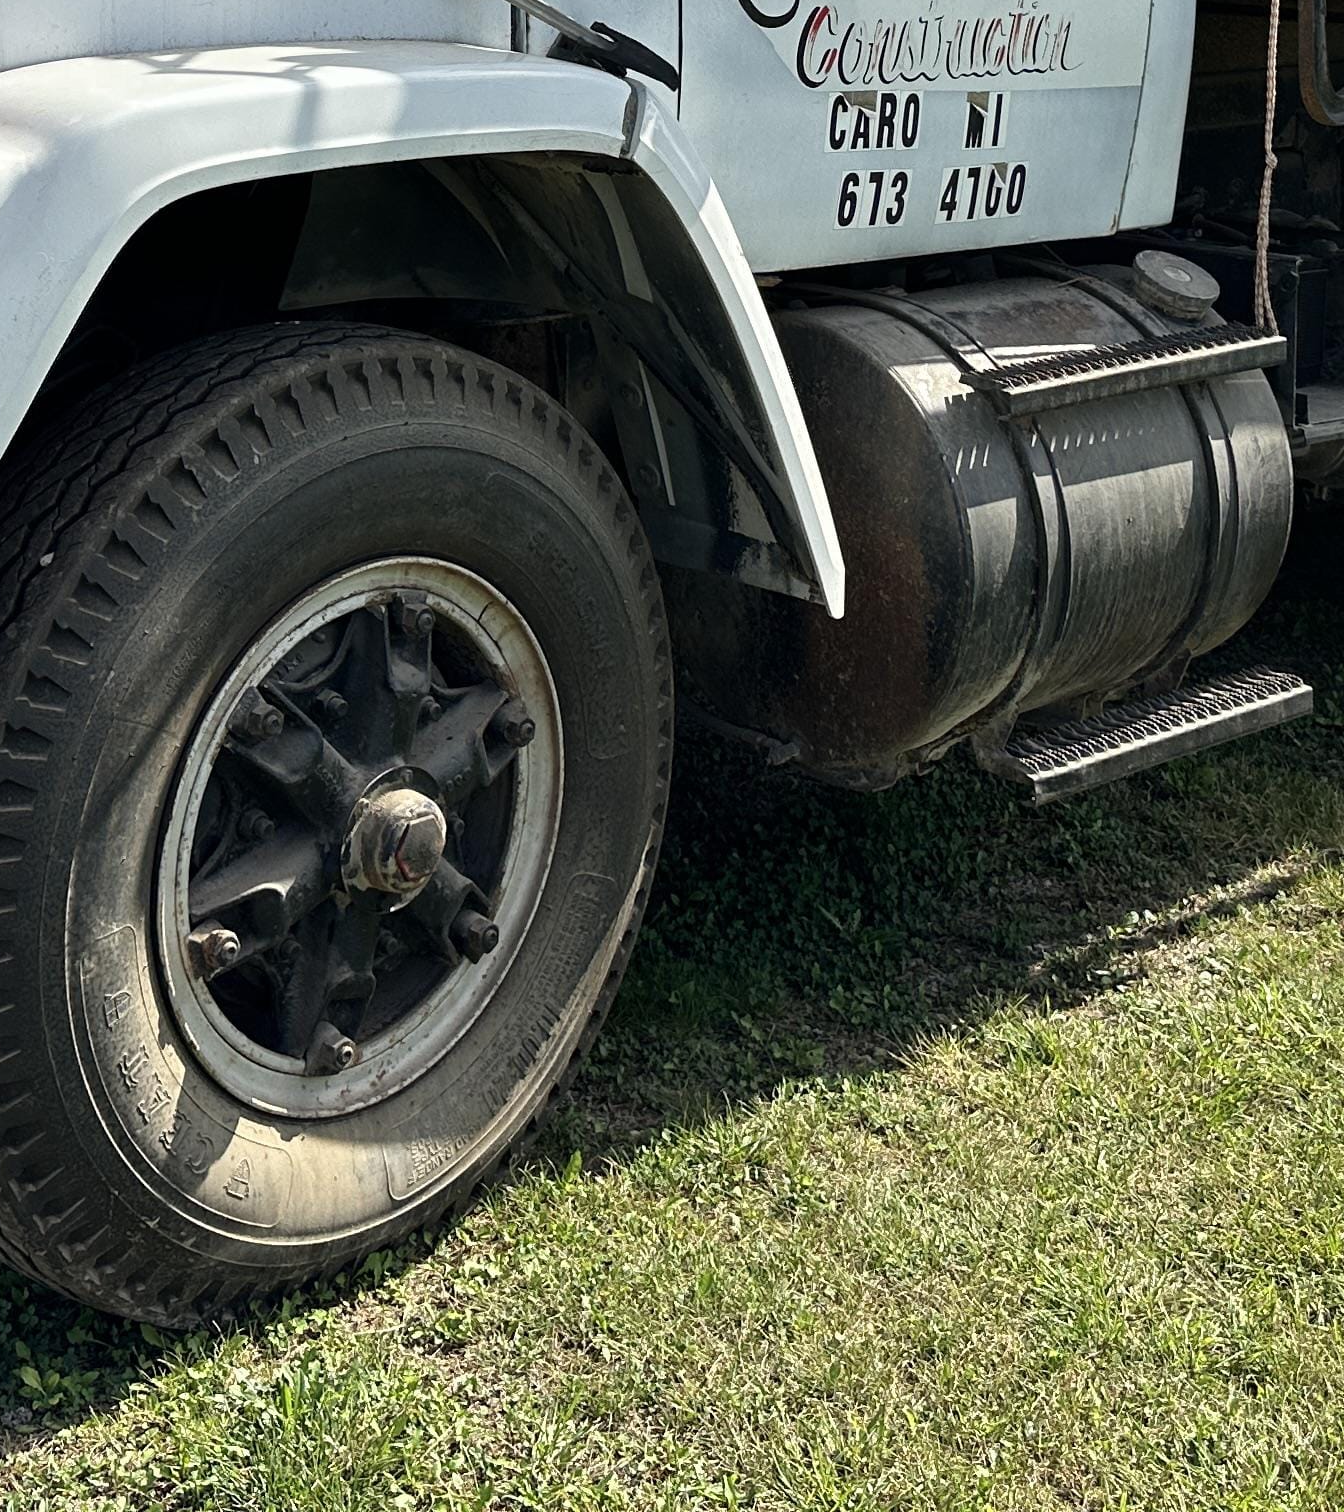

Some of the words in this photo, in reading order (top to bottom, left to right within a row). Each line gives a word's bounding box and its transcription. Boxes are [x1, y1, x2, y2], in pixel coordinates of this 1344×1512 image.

[829, 92, 921, 150] CARO
[965, 93, 1003, 149] MI
[837, 171, 909, 227] 673
[117, 1043, 216, 1176] CEAT
